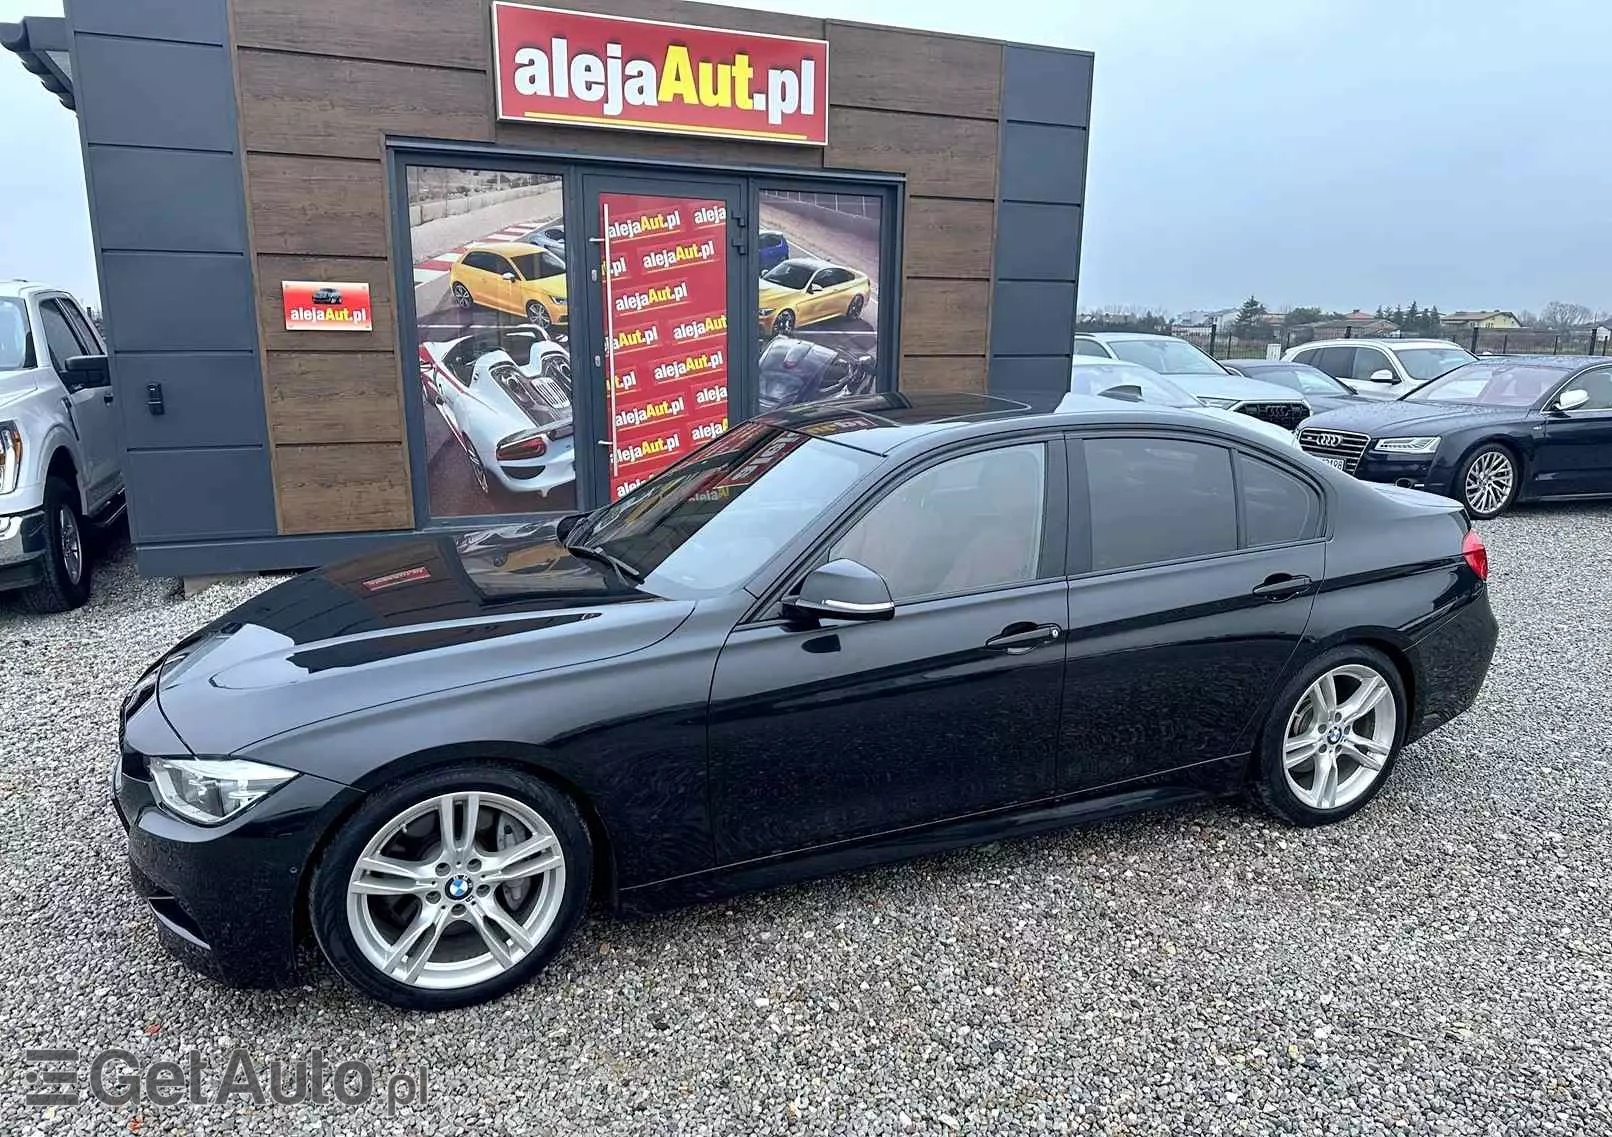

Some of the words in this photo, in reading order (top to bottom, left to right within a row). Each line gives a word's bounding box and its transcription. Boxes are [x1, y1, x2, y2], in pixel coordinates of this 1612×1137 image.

[514, 37, 816, 125] alejaAut.pl
[608, 210, 680, 239] alejaAut.pl
[642, 240, 714, 269] alejaAut.pl
[615, 282, 688, 312] alejaAut.pl
[290, 307, 367, 325] alejaAut.pl
[673, 314, 727, 340] alejaAut
[654, 350, 723, 380] alejaAut.pl
[696, 385, 727, 403] aleja
[615, 397, 684, 427] alejaAut.pl
